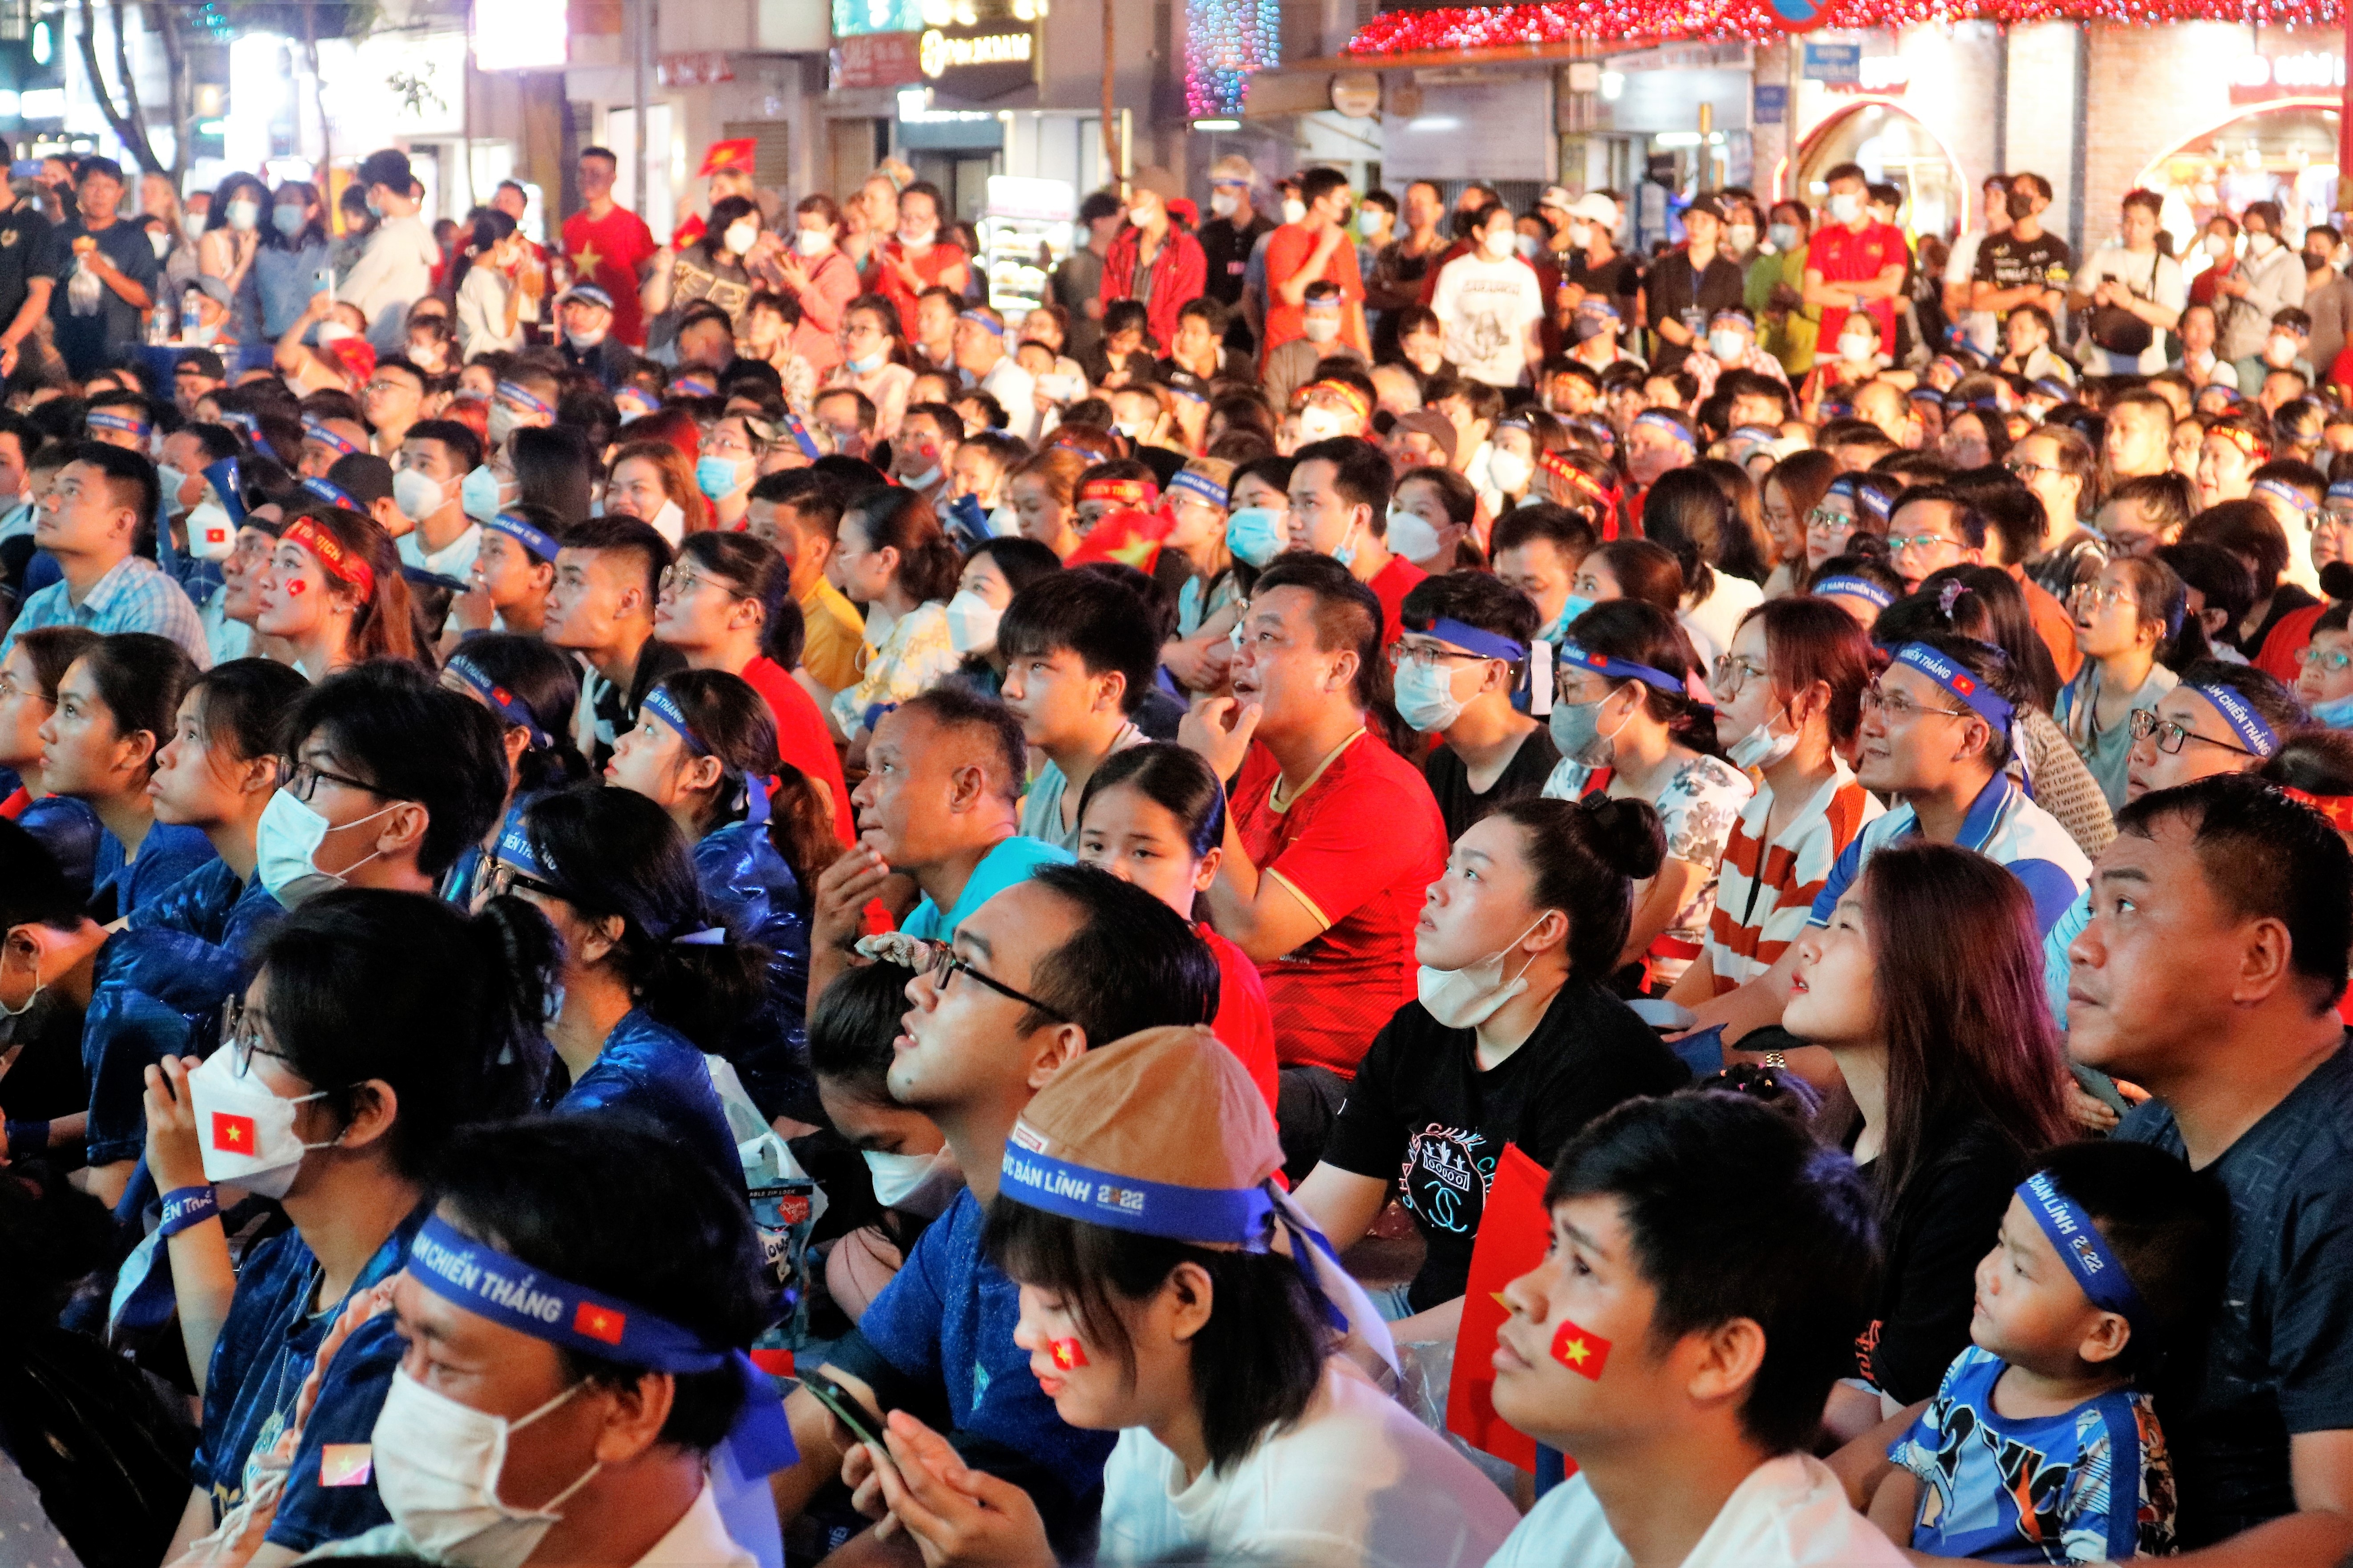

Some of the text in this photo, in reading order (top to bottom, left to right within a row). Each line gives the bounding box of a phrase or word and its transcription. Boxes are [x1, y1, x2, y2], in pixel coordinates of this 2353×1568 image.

[1919, 658, 1952, 679] THẮNG
[2219, 694, 2248, 724] CHIẾN
[2242, 719, 2272, 756] THẮNG
[1013, 1159, 1043, 1188] BẢN
[1044, 1169, 1091, 1202] LĨNH
[2043, 1198, 2079, 1235] LĨNH
[425, 1243, 482, 1290] CHIẾN
[479, 1273, 563, 1323] THẮNG
